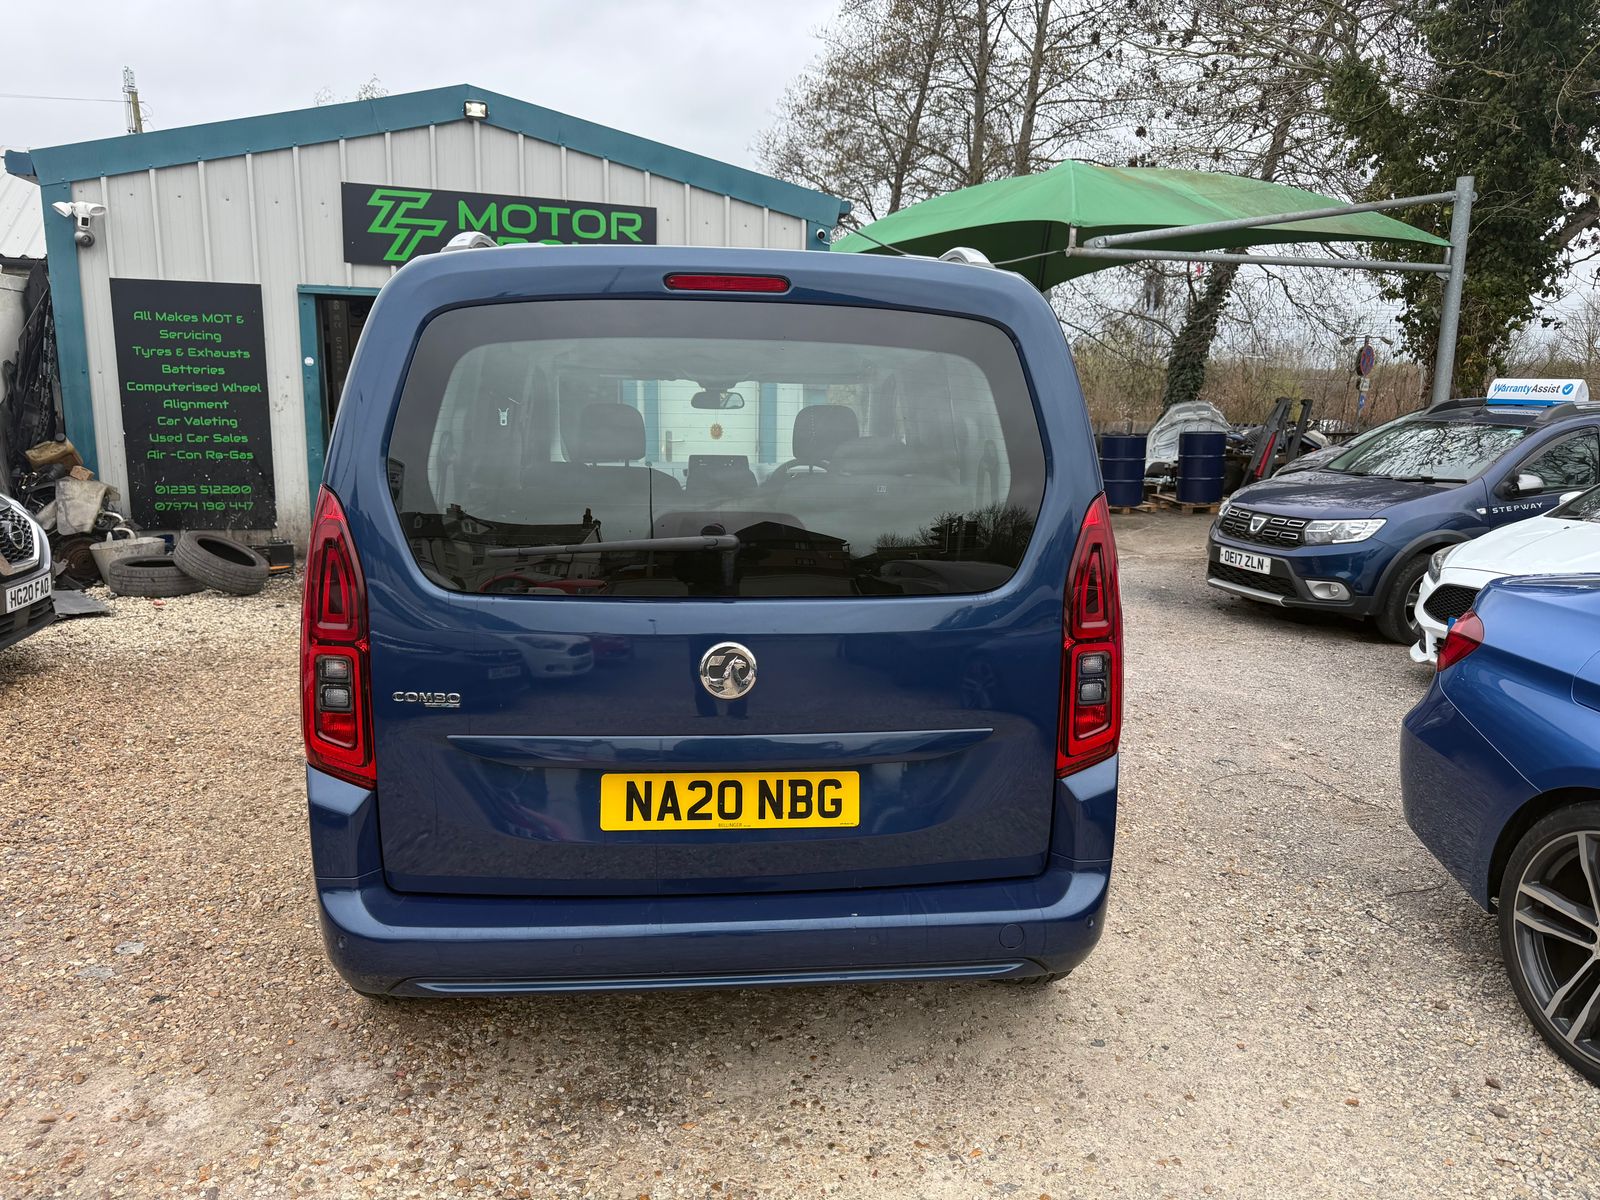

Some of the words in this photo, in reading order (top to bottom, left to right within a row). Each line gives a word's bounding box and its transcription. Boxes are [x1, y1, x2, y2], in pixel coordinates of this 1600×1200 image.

[457, 199, 643, 243] MOTOR
[133, 311, 151, 321] All
[155, 311, 199, 323] Makes
[202, 313, 232, 324] MOT
[236, 315, 245, 324] &
[159, 329, 222, 343] Servicing
[132, 345, 172, 358] Tyres
[176, 348, 183, 357] &
[187, 347, 251, 359] Exhausts
[161, 364, 226, 376] Batteries
[126, 381, 218, 393] Computerised
[222, 383, 262, 393] Wheel
[1494, 383, 1561, 395] WarrantyAssist
[163, 399, 229, 411] Alignment
[157, 416, 181, 426] Car
[184, 416, 239, 429] Valeting
[149, 434, 183, 444] Used
[186, 434, 209, 444] Car
[213, 434, 249, 444] Sales
[206, 450, 254, 460] Re-Gas
[155, 485, 196, 495] 01235
[200, 485, 252, 495] 512200
[155, 501, 198, 511] 07974
[202, 501, 226, 511] 190
[229, 502, 254, 511] 447
[1492, 502, 1543, 514] STEPWAY
[1225, 550, 1243, 565] OE17
[1244, 555, 1264, 570] ZLN
[9, 584, 34, 609] HG20
[392, 691, 461, 703] COMBO
[625, 780, 743, 822] NA20
[758, 779, 843, 820] NBG
